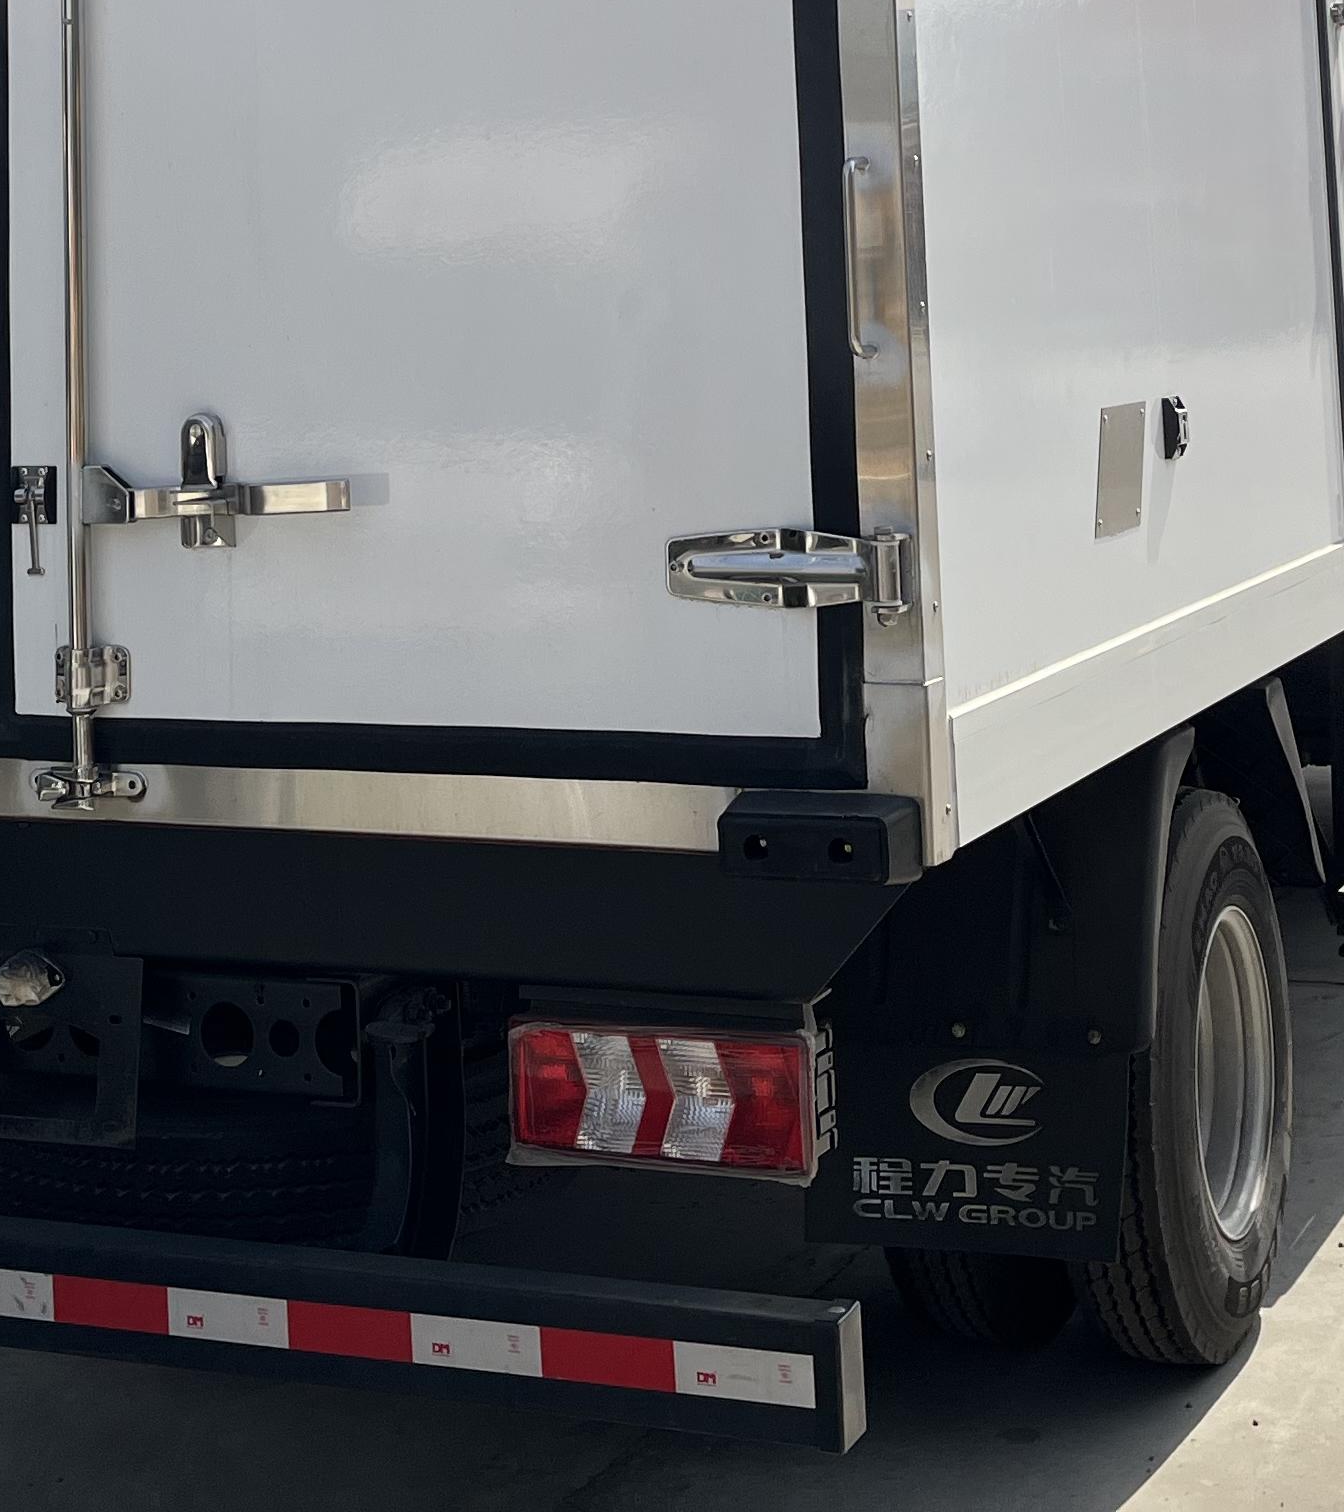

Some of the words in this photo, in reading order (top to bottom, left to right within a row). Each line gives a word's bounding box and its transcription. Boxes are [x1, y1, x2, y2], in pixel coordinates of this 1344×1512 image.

[852, 1157, 1100, 1207] 程力专汽
[852, 1199, 951, 1221] CLW
[958, 1204, 1098, 1232] GROUP
